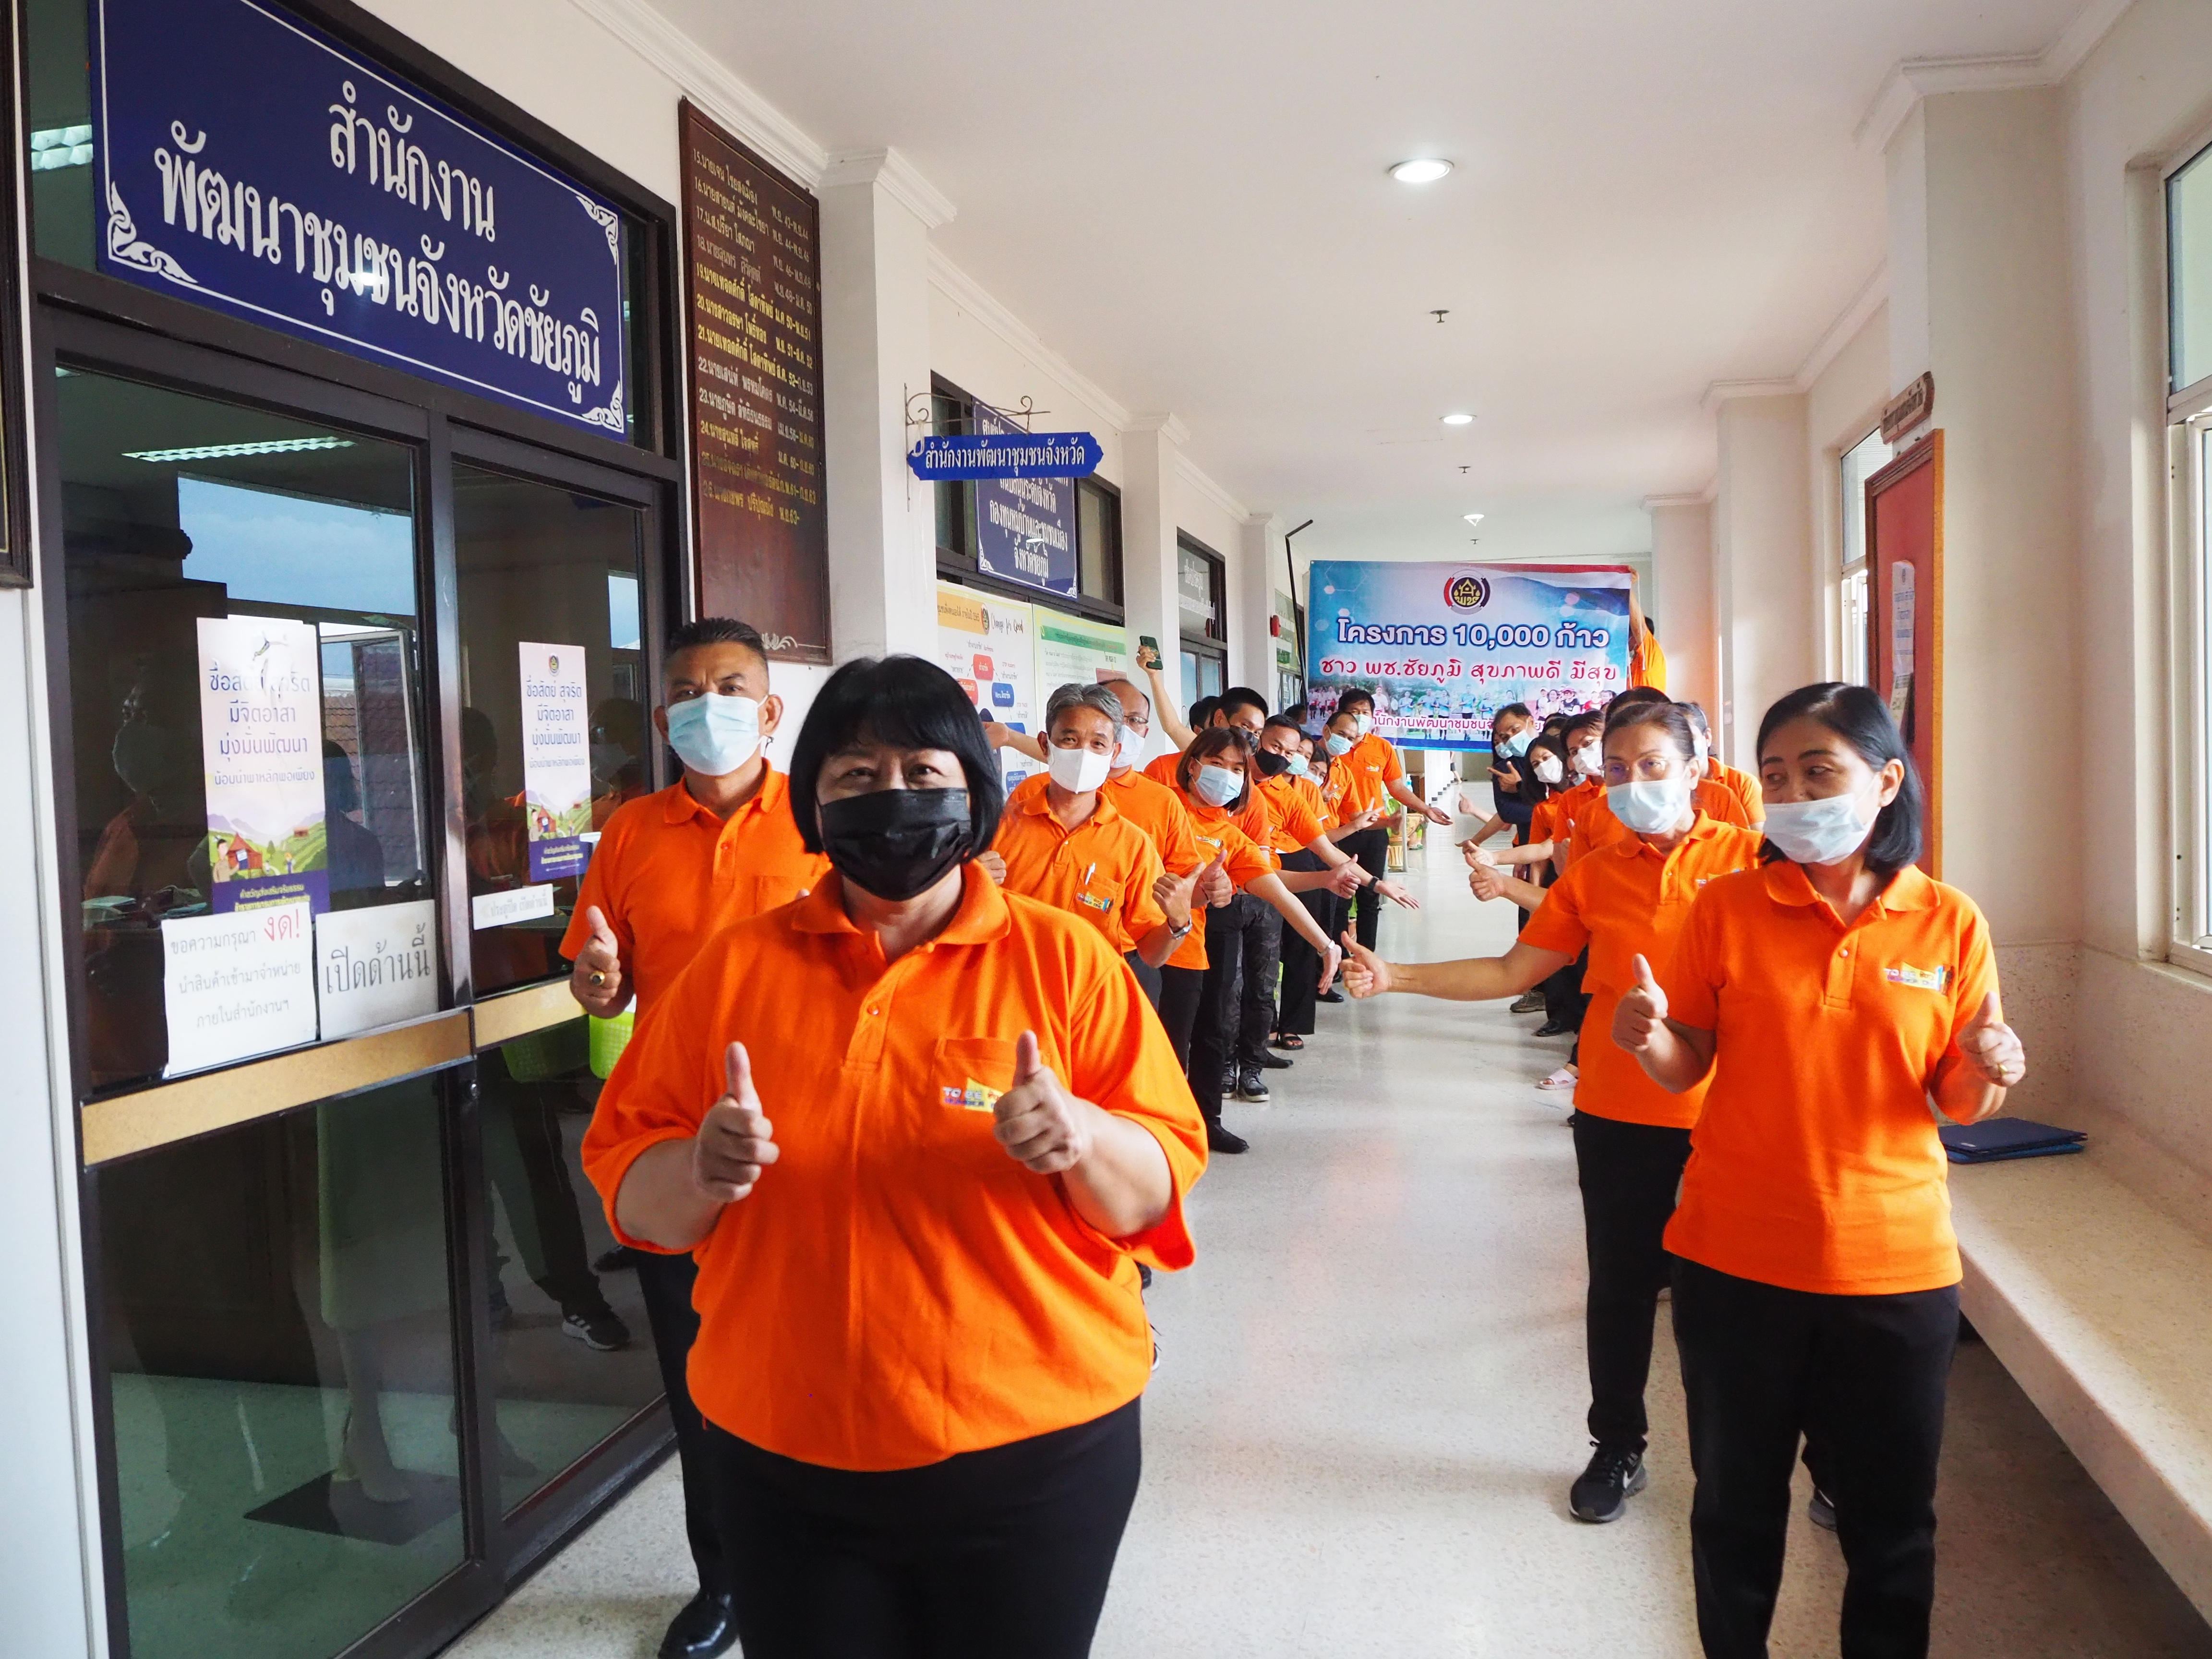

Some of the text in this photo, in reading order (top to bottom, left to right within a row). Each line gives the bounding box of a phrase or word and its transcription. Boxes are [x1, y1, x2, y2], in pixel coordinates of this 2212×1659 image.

[329, 81, 496, 242] สำนักงาน
[154, 120, 600, 404] พัฒนาชุมชนจังหวัดชัยภูมิ
[926, 437, 1085, 476] สำนักงานพัฒนาชุมชนจังหวัด
[1337, 617, 1610, 649] โครงการ 10,000 ก้าว
[209, 661, 264, 691] ซื่อส
[1322, 658, 1616, 686] ชาว พช.ชัยภูมิ สุขภาพดี มีสุข
[560, 681, 582, 703] สุจริต
[229, 699, 296, 722] มีจิตอาสา
[537, 704, 574, 721] มีจิตอาสา
[220, 726, 308, 762] มุ่งมั่นพัฒนา
[532, 723, 581, 751] มุ่งมั่นพัฒนา
[170, 909, 300, 955] ขอความกรุณา งด!
[326, 922, 431, 995] เปิดด้านนี้
[179, 960, 301, 994] นำสินค้าเข้ามาจำหน่าย
[942, 1086, 962, 1098] TO
